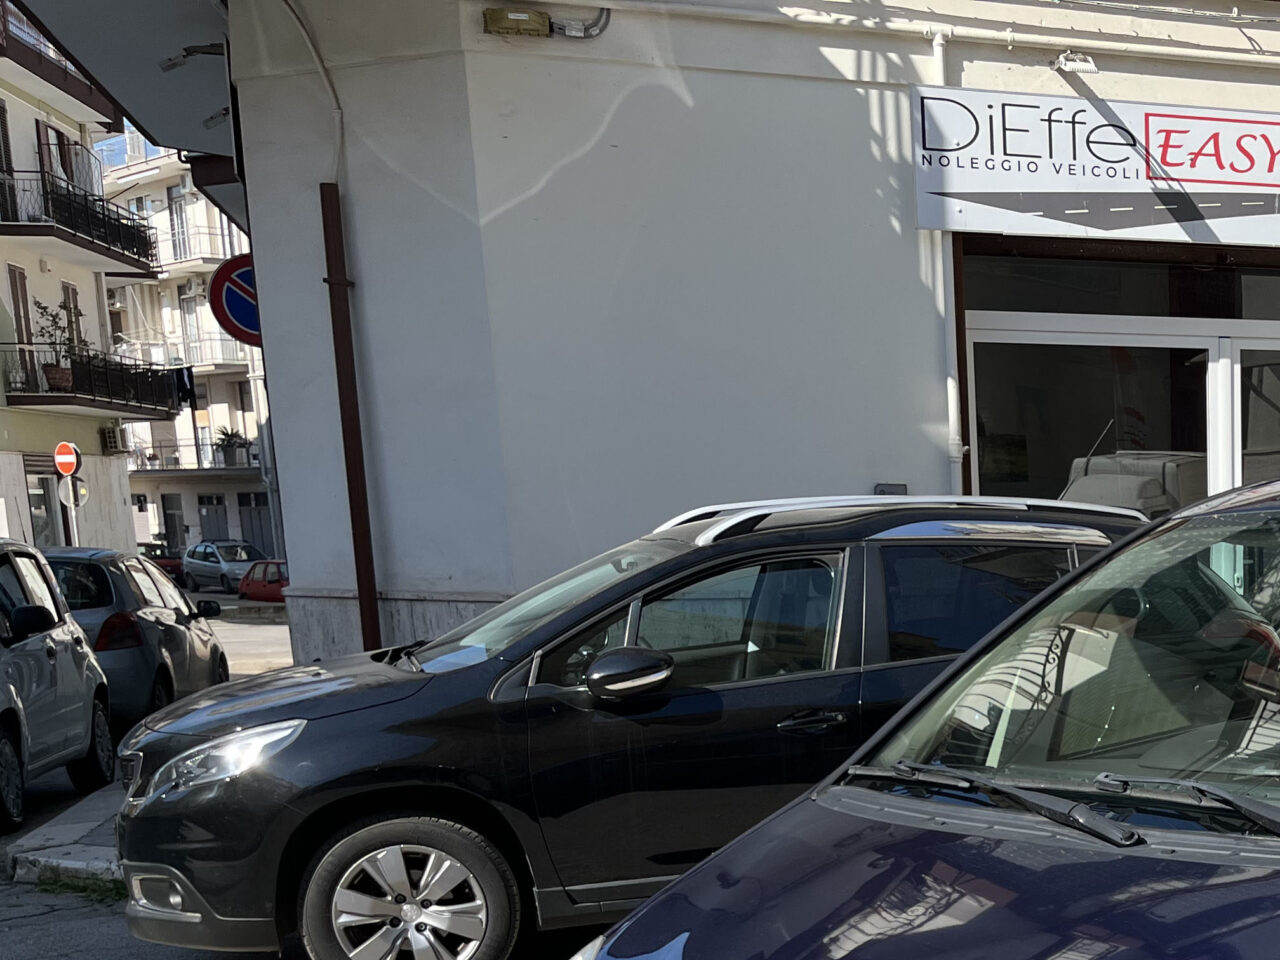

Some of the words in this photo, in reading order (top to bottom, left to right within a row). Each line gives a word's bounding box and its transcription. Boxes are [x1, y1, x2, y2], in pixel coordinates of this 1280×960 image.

[920, 96, 1137, 163] DiEffe
[921, 153, 1039, 173] NOLEGGIO
[1052, 162, 1139, 180] VEICOLI
